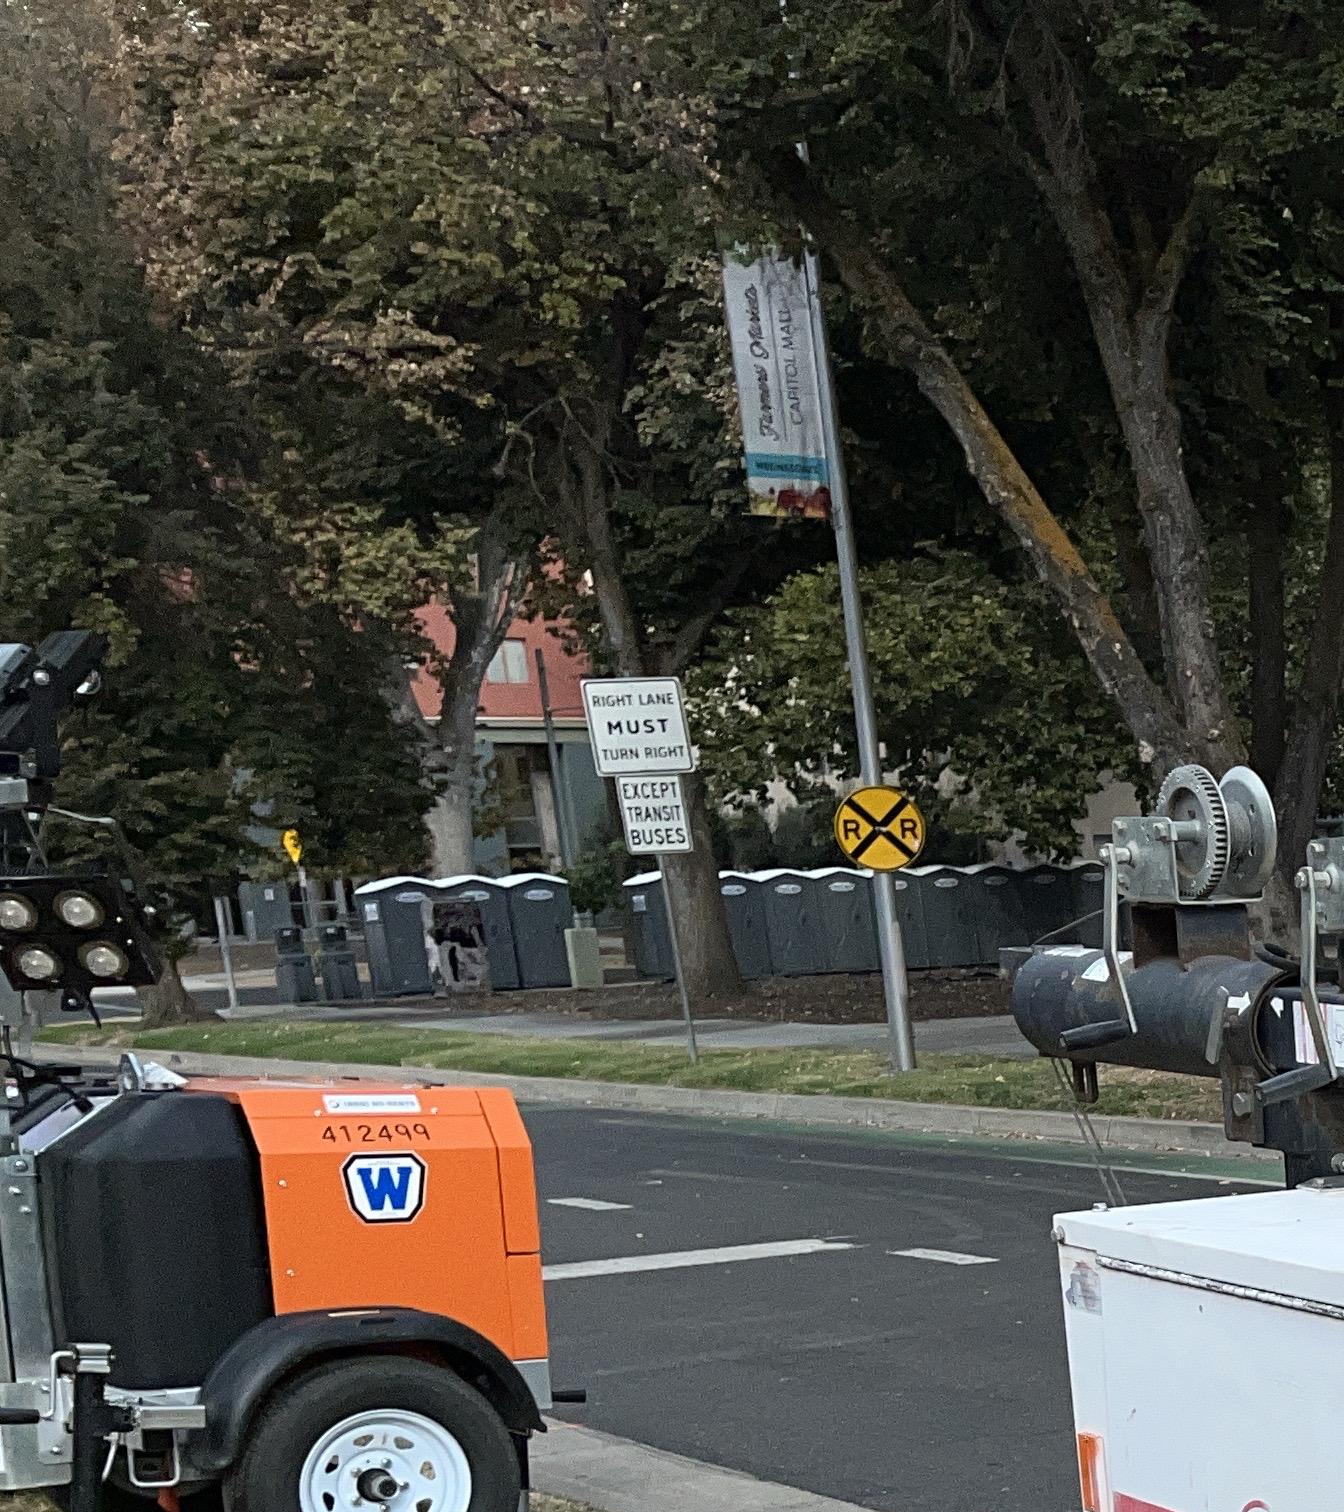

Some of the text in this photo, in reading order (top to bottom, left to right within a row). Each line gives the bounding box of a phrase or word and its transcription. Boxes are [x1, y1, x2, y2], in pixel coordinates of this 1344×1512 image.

[783, 354, 803, 426] CAPITOL
[592, 692, 674, 708] RIGHT LANE
[607, 718, 669, 735] MUST
[602, 745, 684, 761] TURN RIGHT
[622, 781, 677, 800] EXCEPT
[627, 805, 681, 823] TRANSIT
[630, 827, 686, 846] BUSES
[843, 818, 918, 840] R R
[321, 1123, 431, 1142] 412499
[356, 1166, 412, 1210] W
